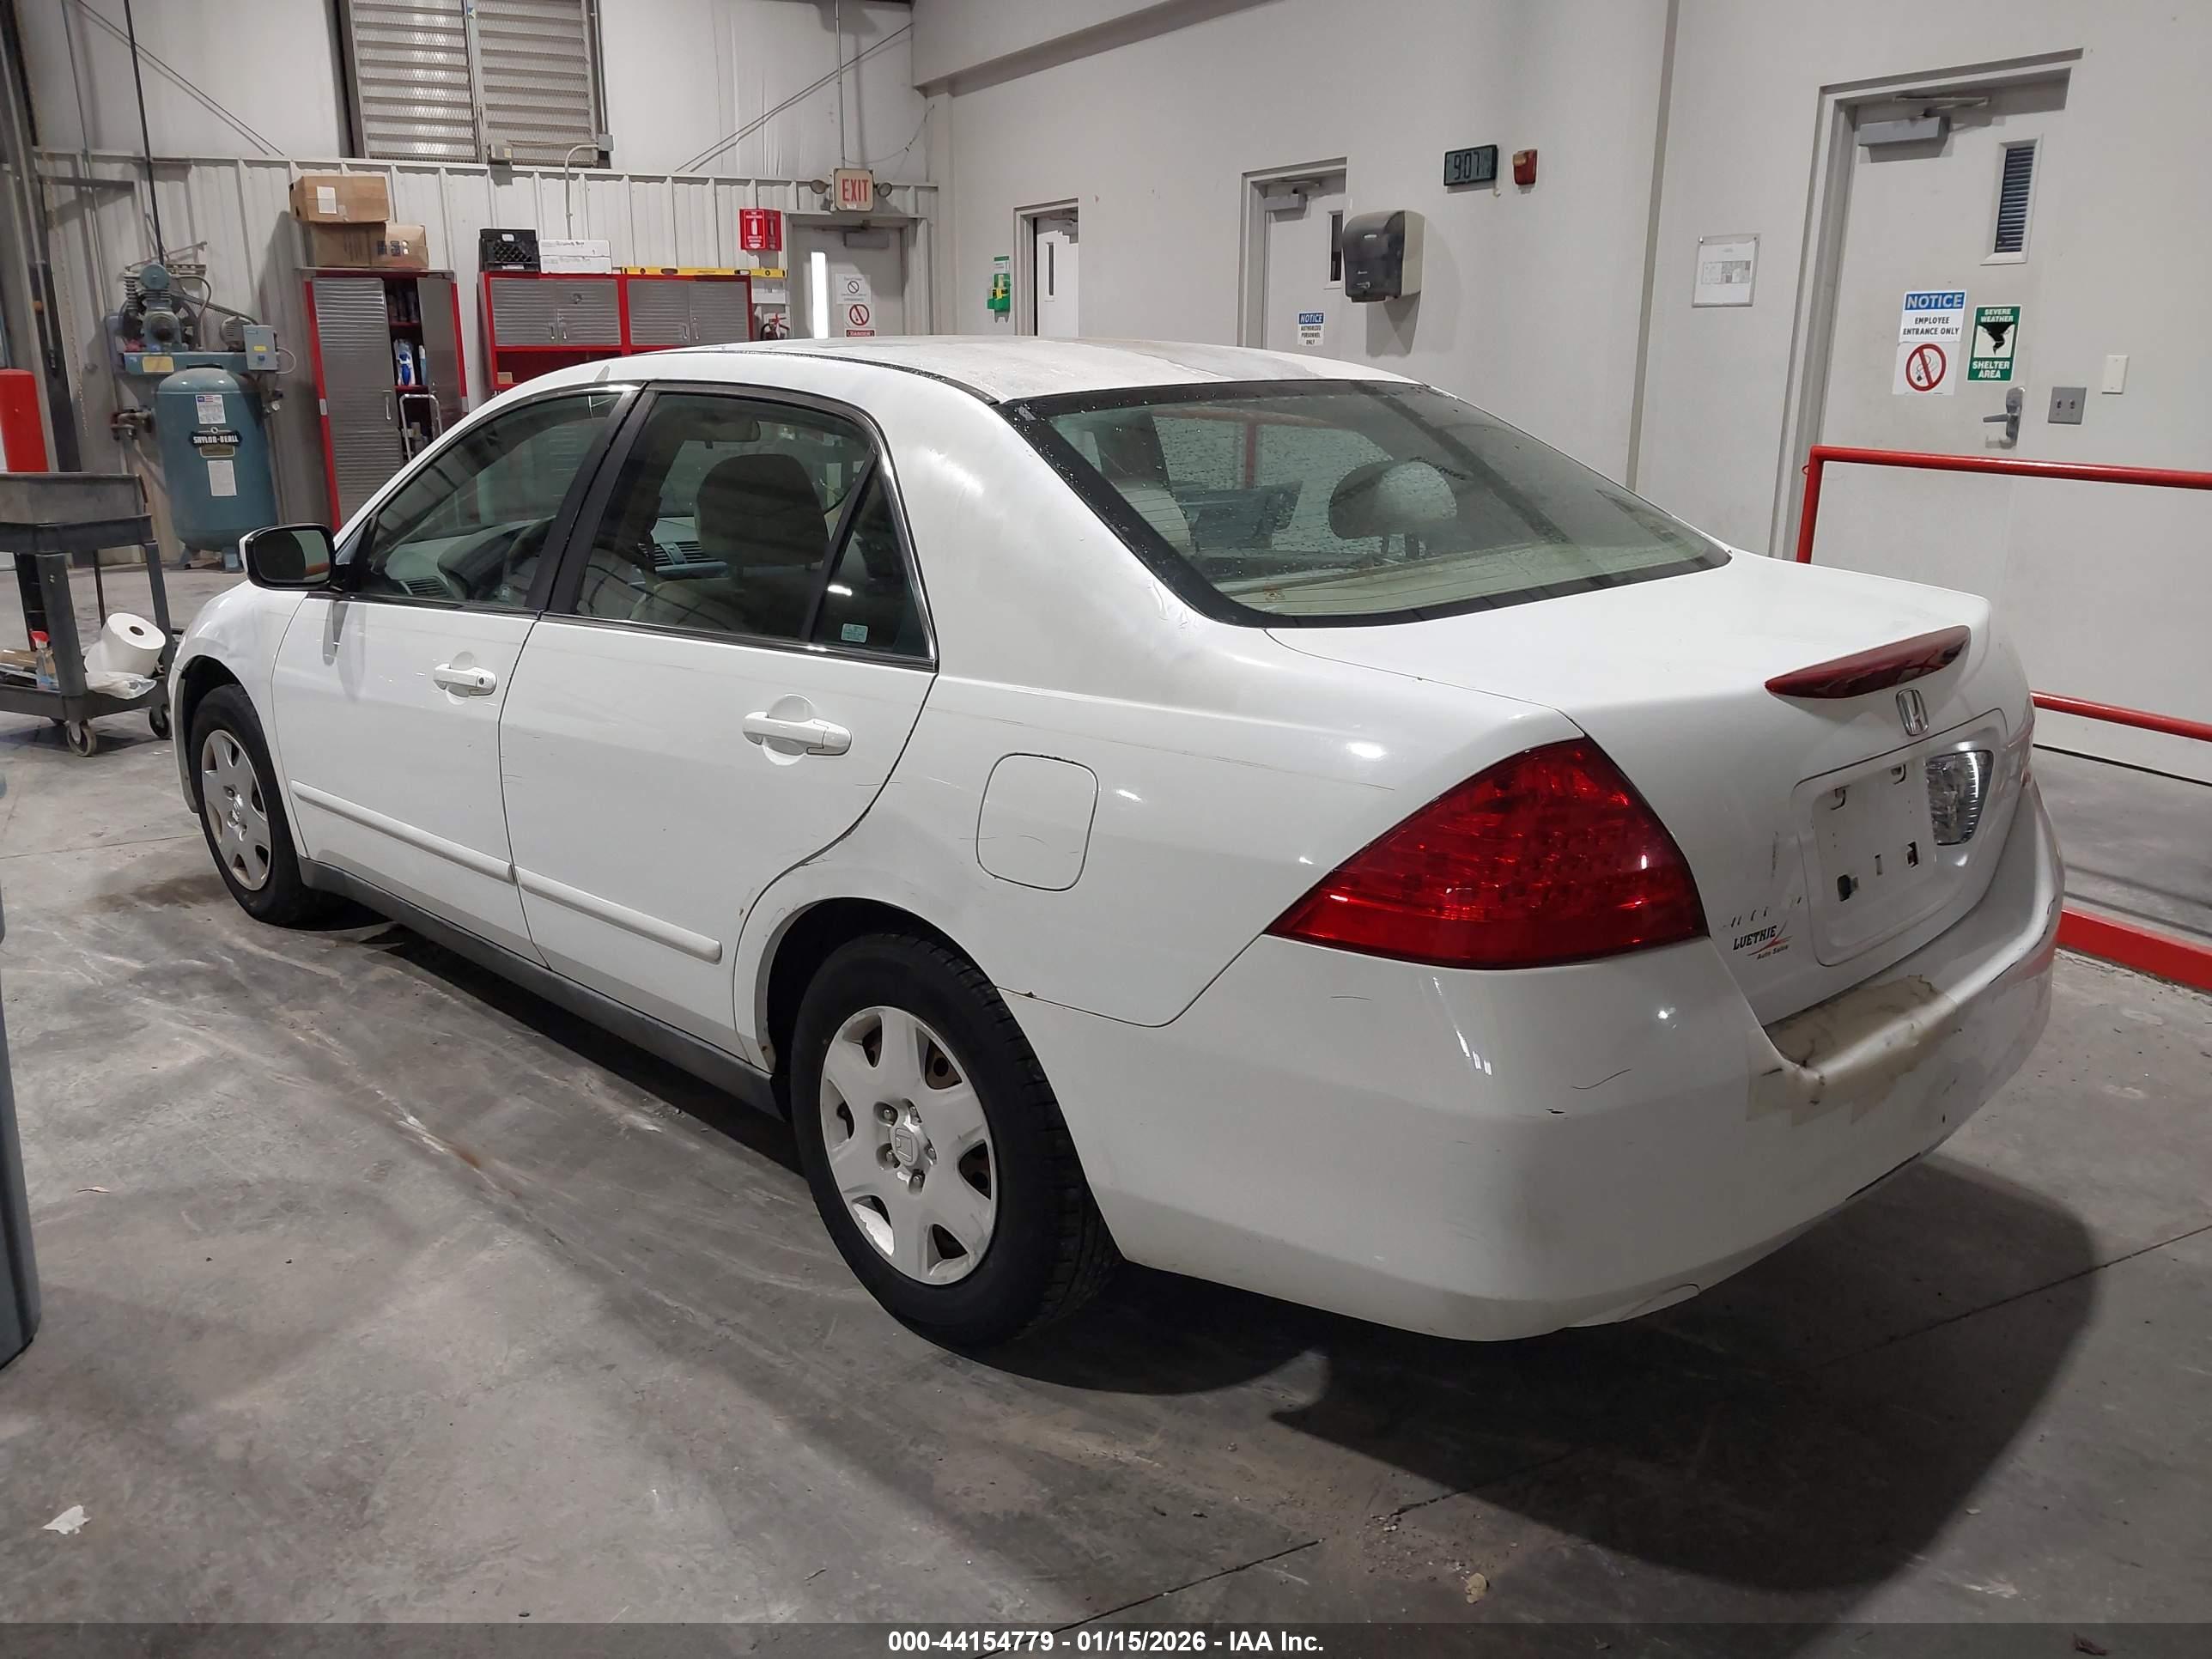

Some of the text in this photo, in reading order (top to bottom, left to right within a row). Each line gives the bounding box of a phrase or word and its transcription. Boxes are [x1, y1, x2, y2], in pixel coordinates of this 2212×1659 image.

[842, 178, 869, 202] EXIT
[1906, 294, 1963, 309] NOTICE
[1300, 313, 1323, 324] NOTICE
[1915, 316, 1950, 325] EMPLOYEE
[1903, 326, 1960, 336] ENTRANCE ONLY
[1972, 361, 2010, 369] SHELTER
[1978, 369, 2002, 378] AREA
[1733, 925, 1778, 951] LUETHIE
[1757, 951, 1771, 960] Auto
